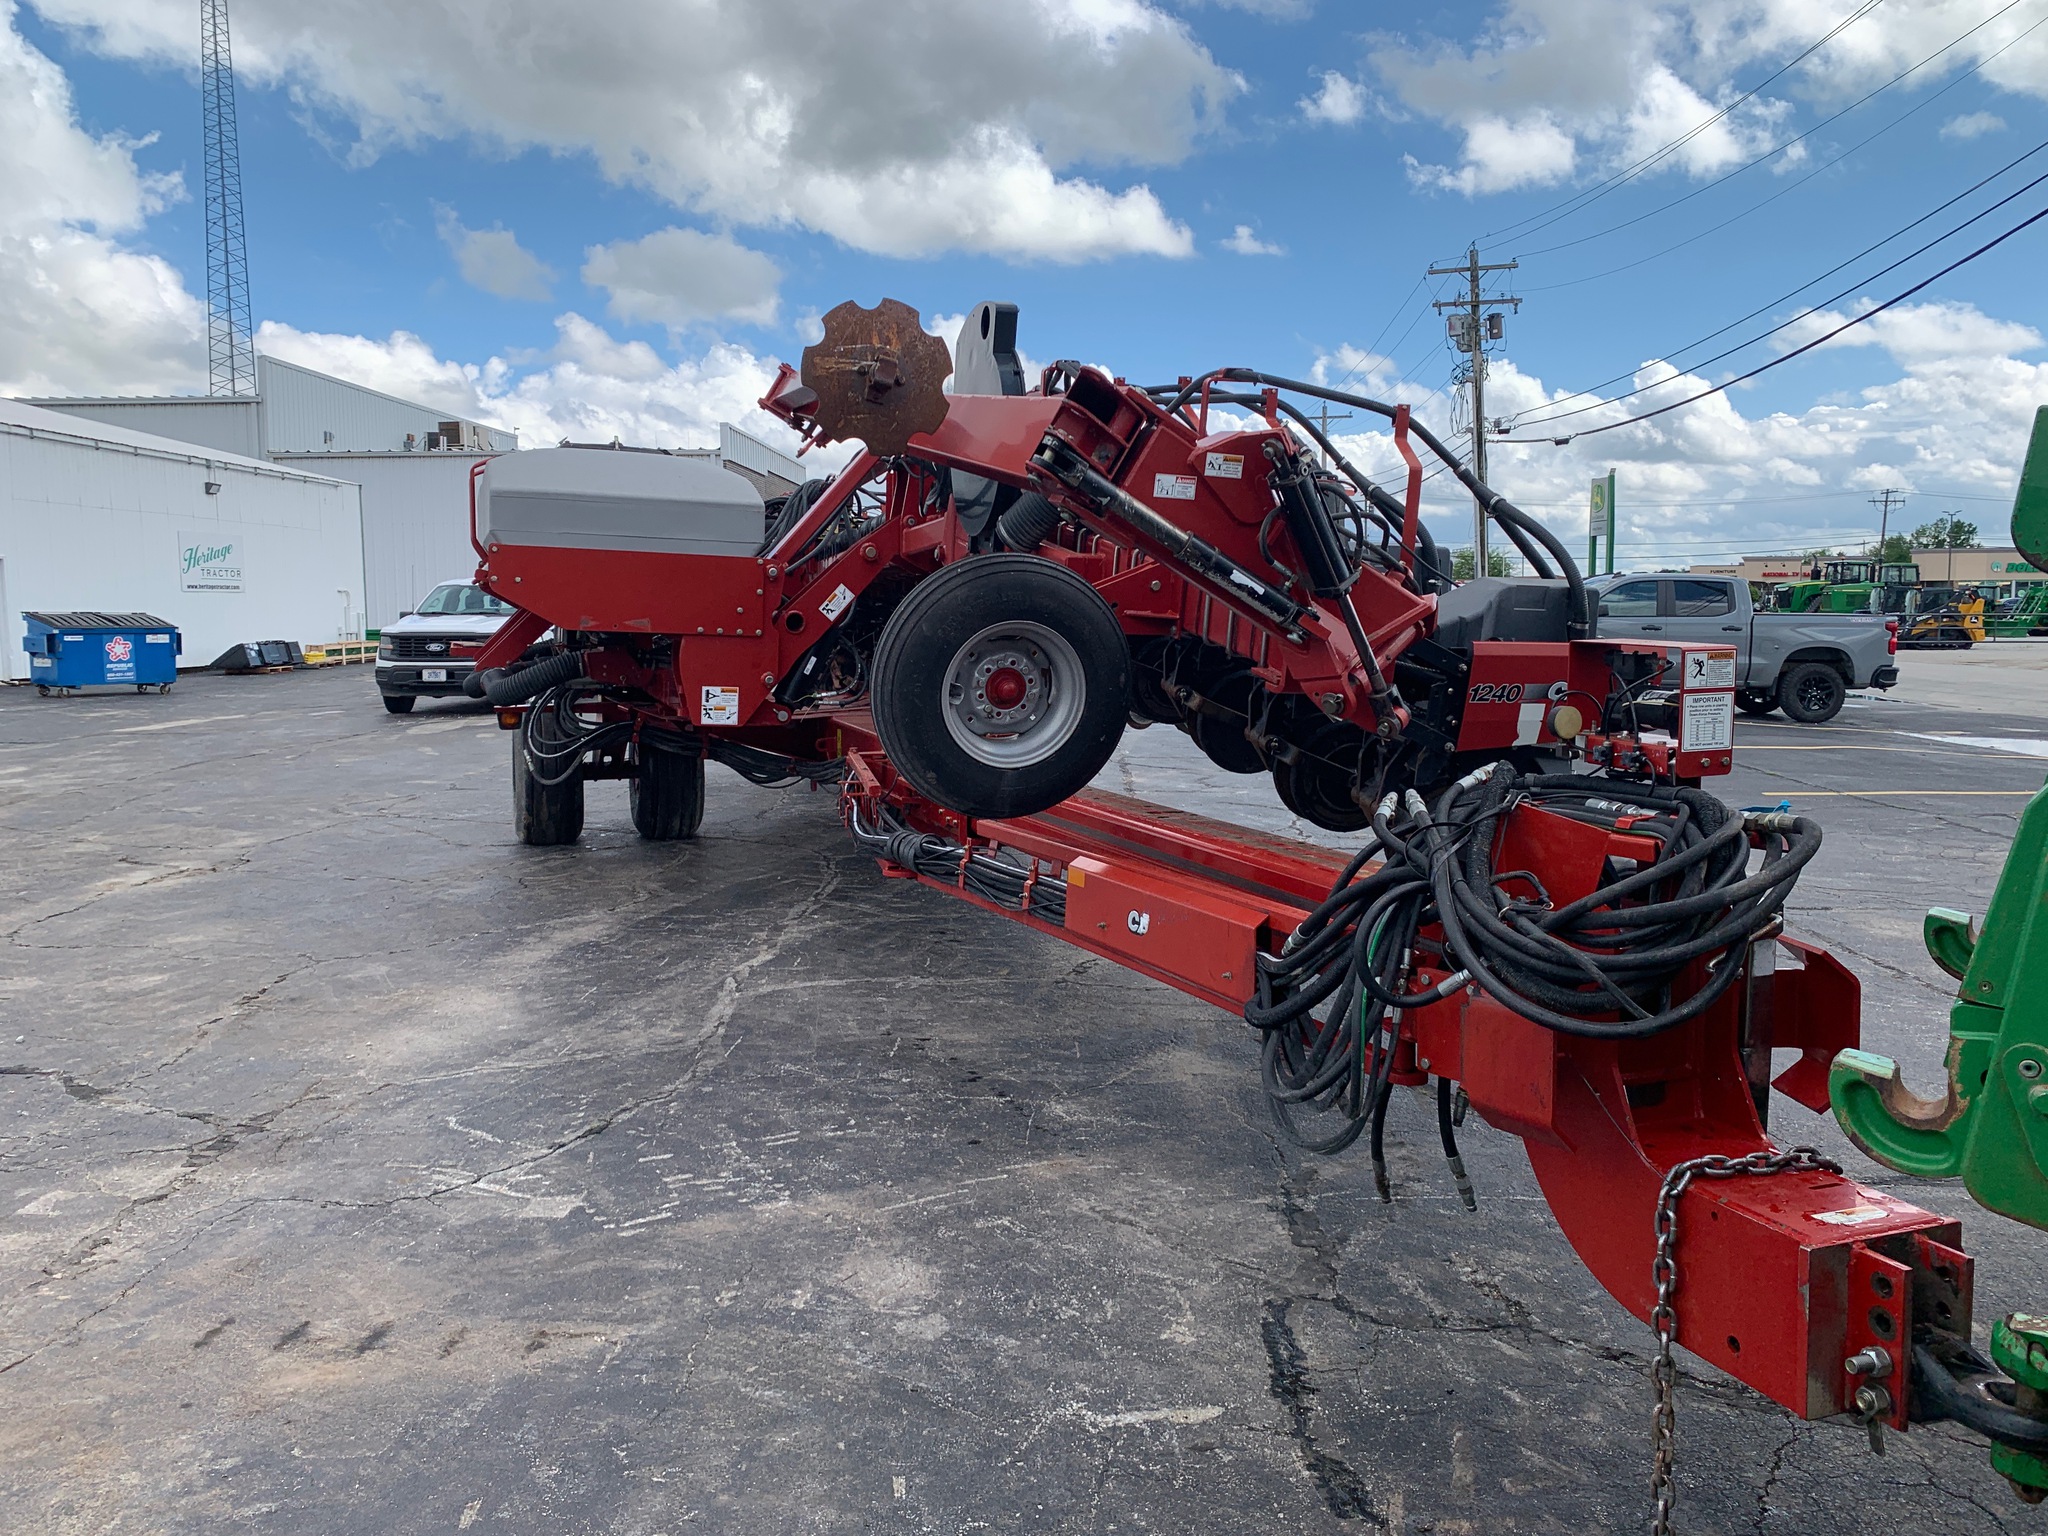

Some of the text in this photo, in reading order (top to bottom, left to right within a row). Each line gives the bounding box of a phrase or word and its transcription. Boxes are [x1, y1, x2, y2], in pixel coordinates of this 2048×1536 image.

[182, 544, 232, 574] Heritage
[201, 569, 241, 578] TRACTOR
[1469, 683, 1522, 703] 1240
